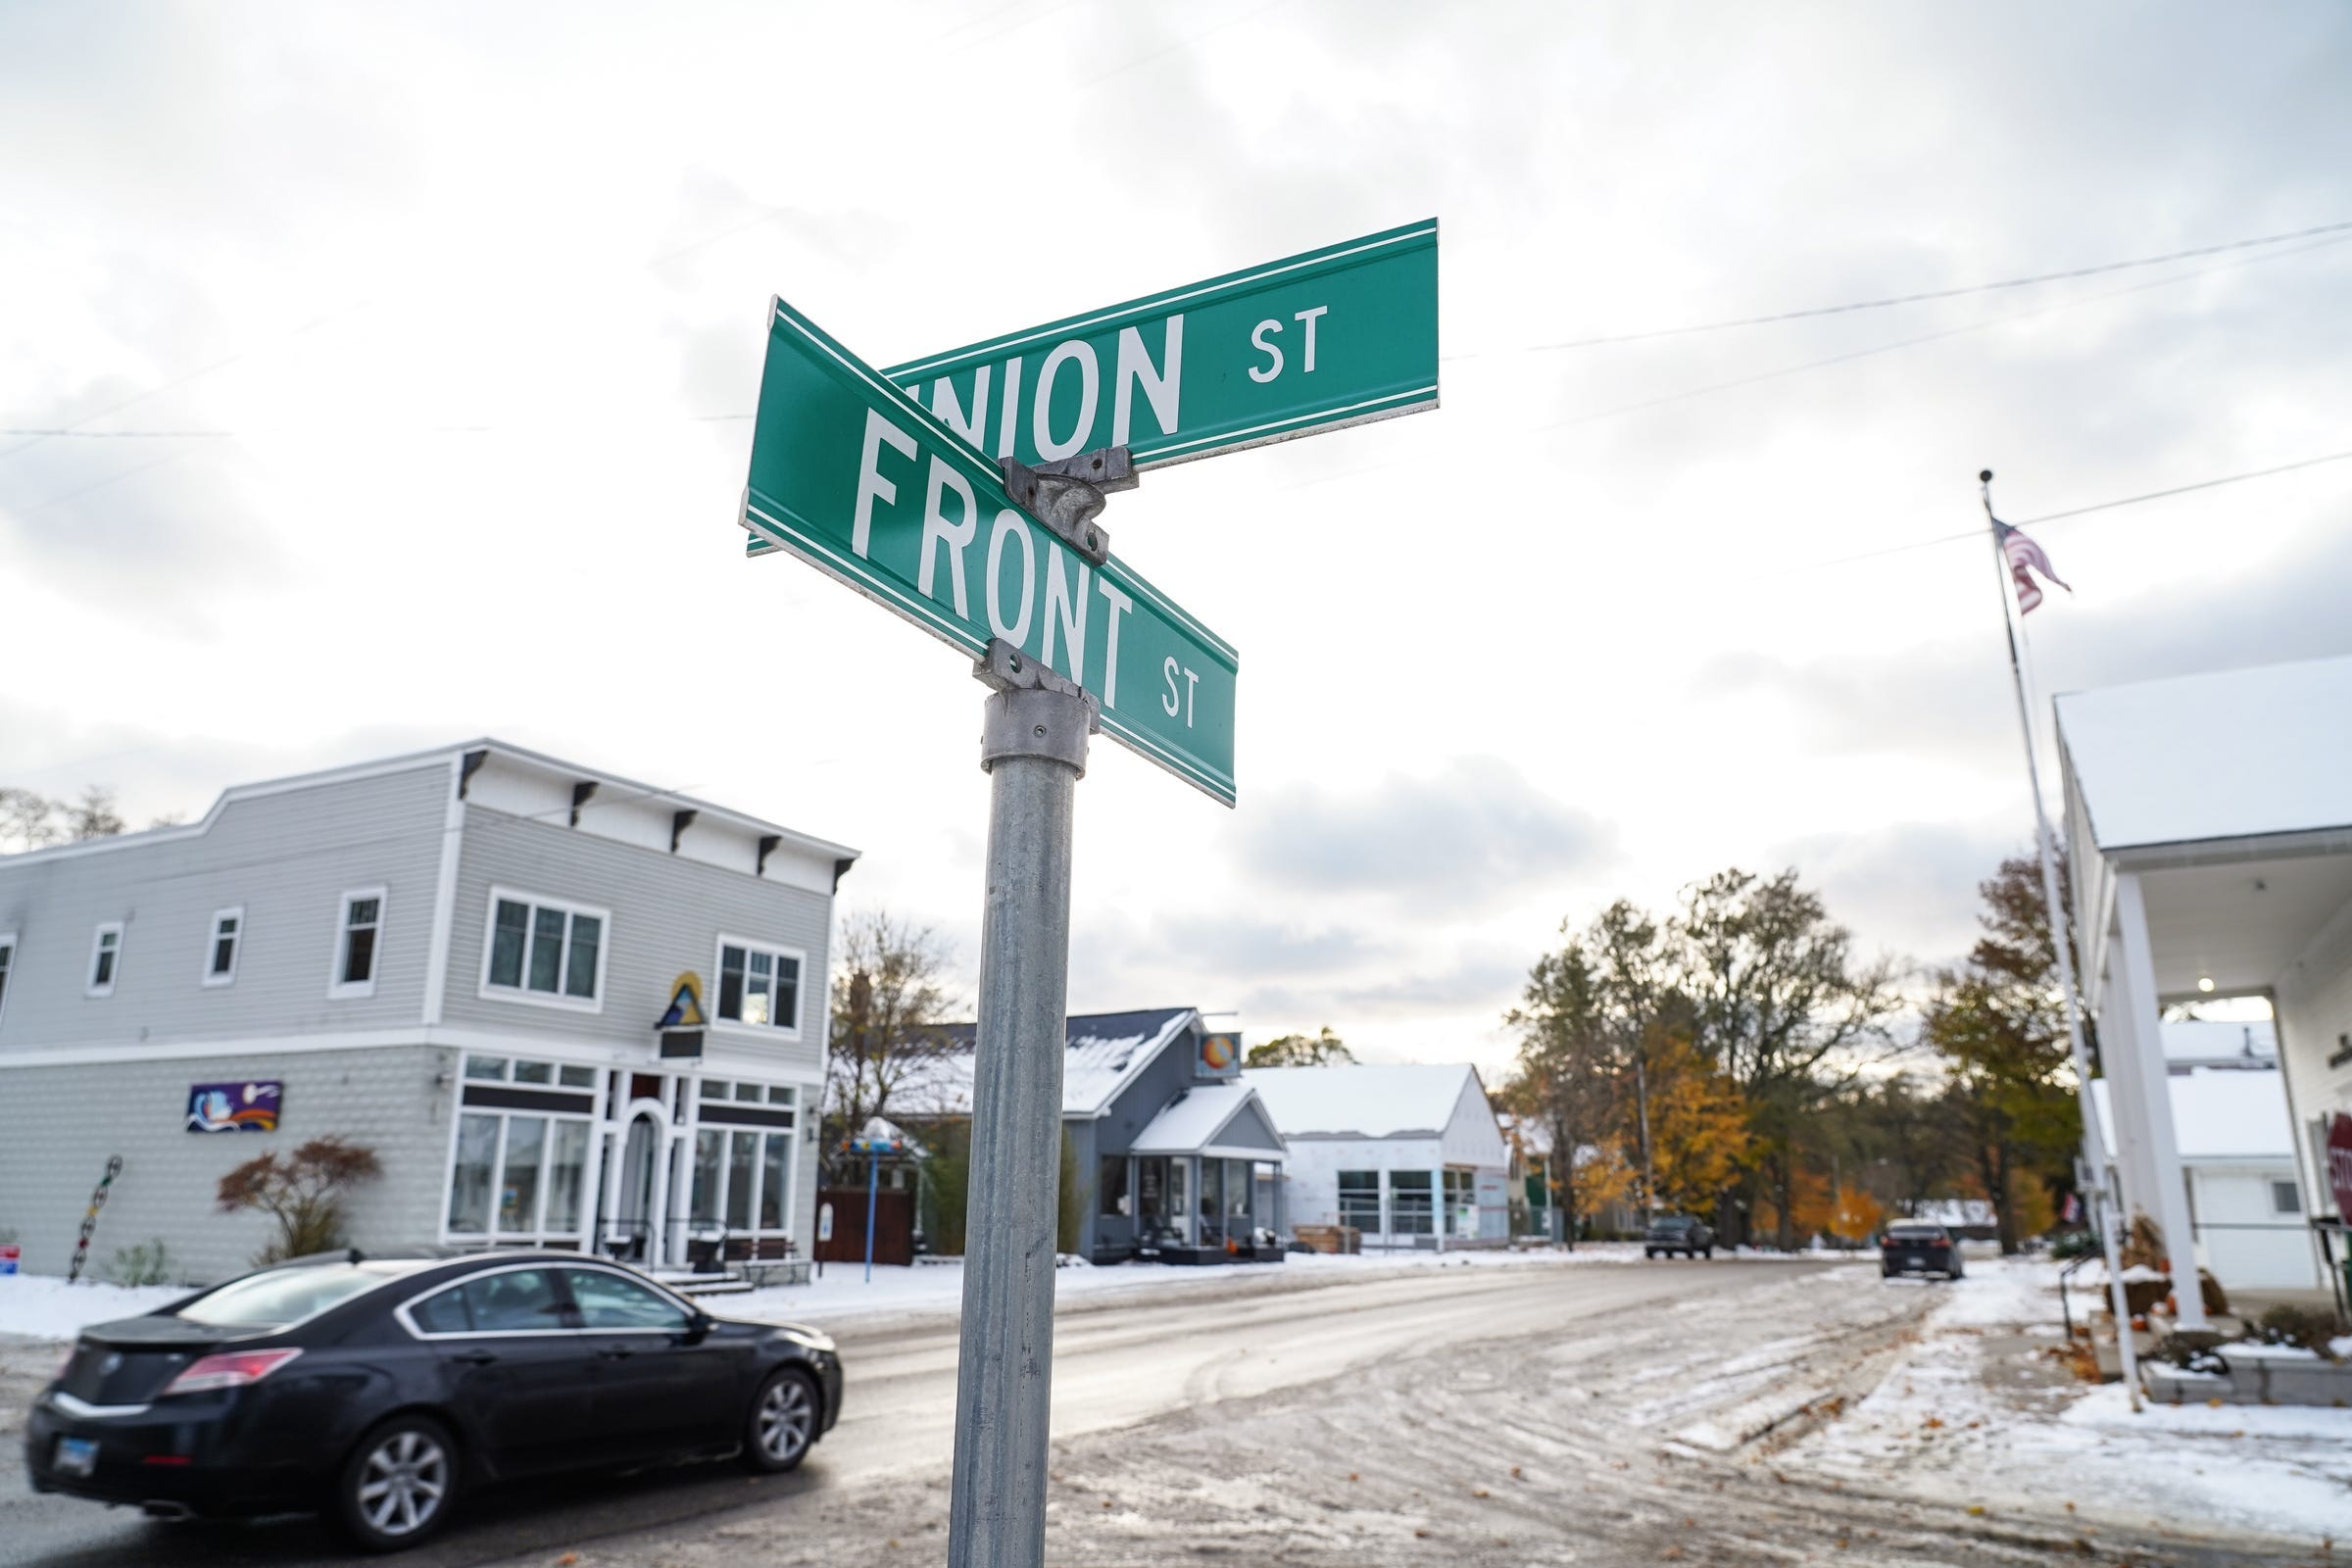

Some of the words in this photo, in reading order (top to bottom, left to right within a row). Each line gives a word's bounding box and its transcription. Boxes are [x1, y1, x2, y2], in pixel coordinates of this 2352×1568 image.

[906, 314, 1184, 464] NION
[1248, 306, 1328, 383] ST
[852, 407, 1133, 711] FRONT
[1162, 656, 1200, 729] ST
